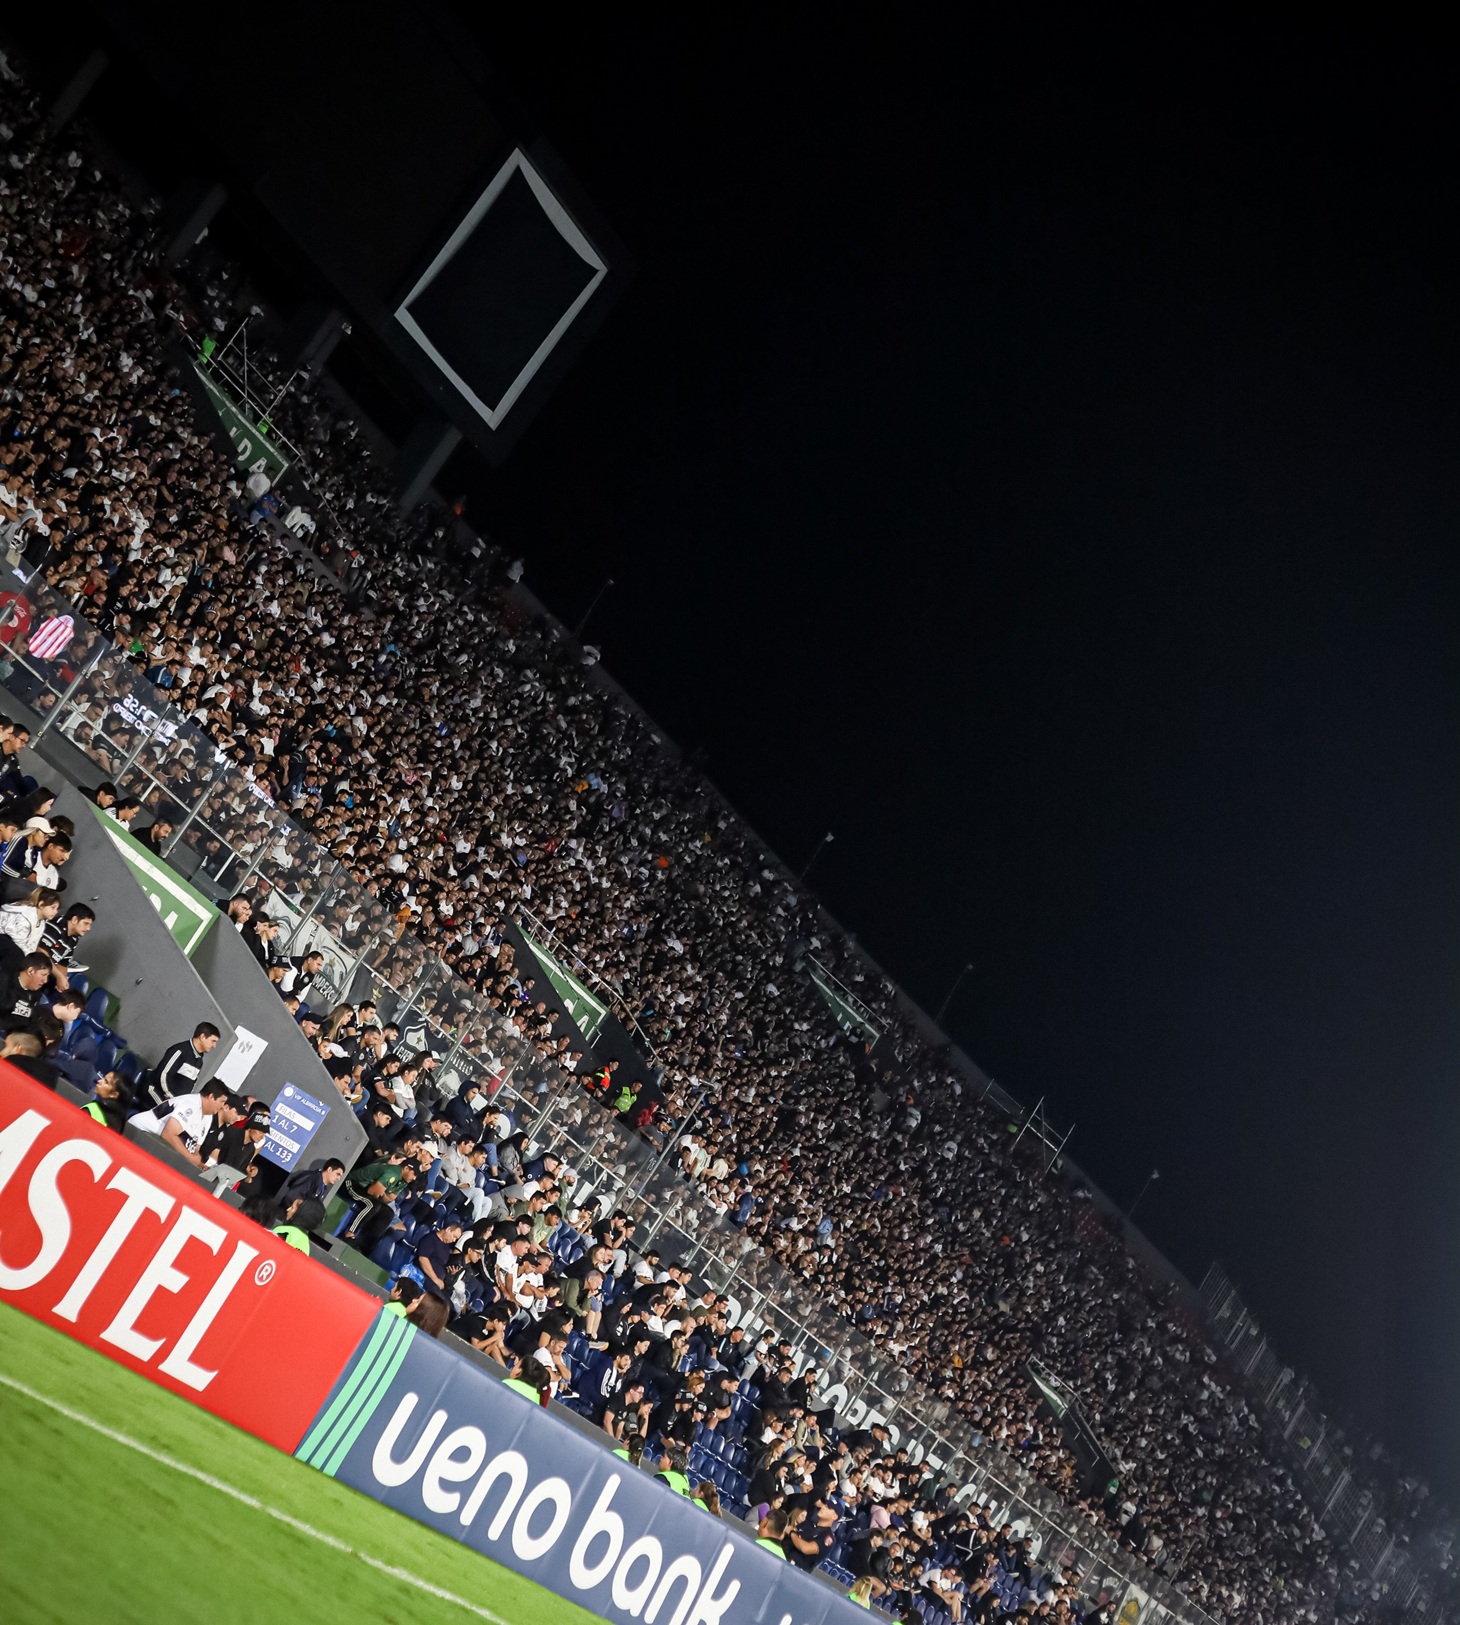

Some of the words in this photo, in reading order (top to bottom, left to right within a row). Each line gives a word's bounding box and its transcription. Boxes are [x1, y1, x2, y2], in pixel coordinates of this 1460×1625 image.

[279, 1105, 295, 1120] FILAS
[272, 1114, 279, 1123] 1
[278, 1119, 288, 1131] AL
[290, 1125, 298, 1134] 7
[269, 1129, 295, 1150] SIENTOS
[264, 1141, 274, 1152] AL
[275, 1147, 293, 1162] 133
[371, 1391, 572, 1561] ueno
[569, 1473, 741, 1625] bank
